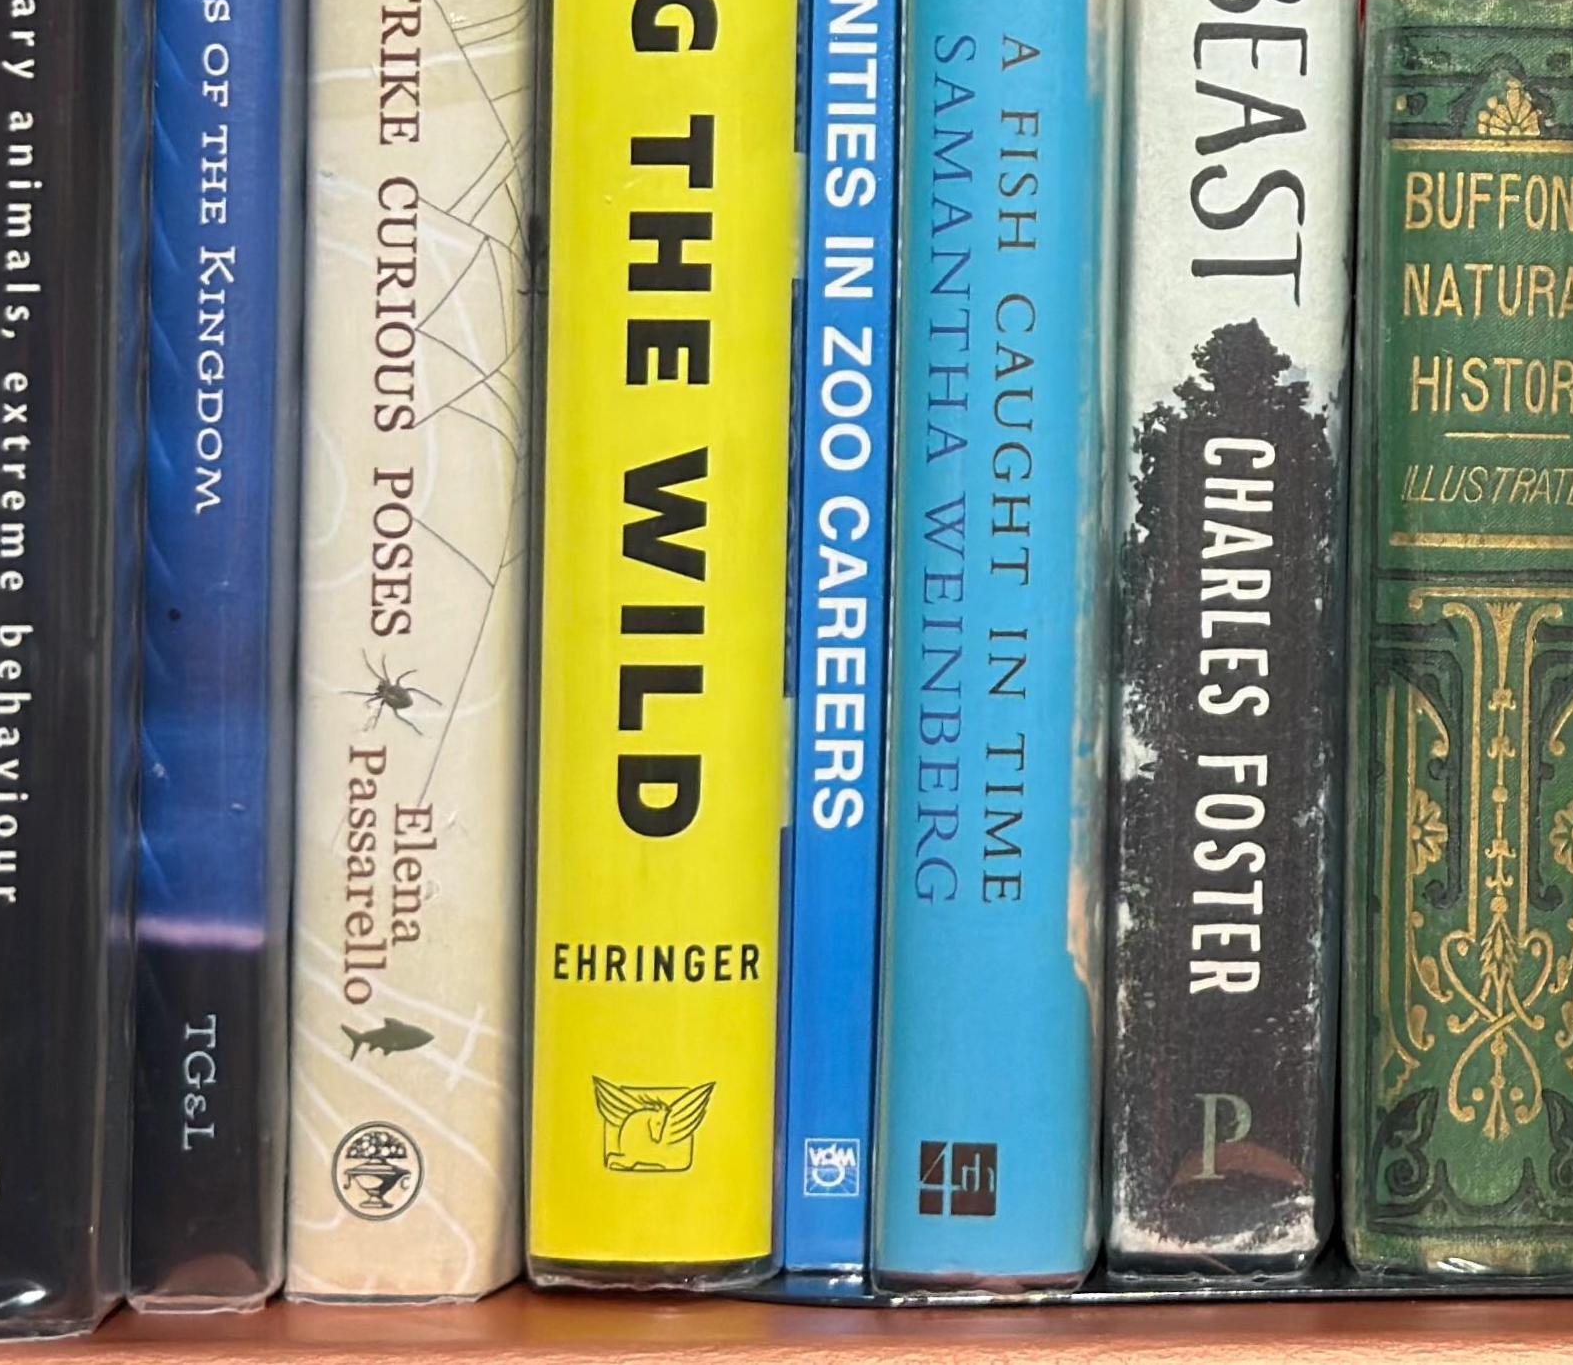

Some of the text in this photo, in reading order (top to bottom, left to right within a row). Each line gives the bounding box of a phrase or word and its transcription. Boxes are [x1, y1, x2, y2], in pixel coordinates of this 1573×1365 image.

[200, 124, 228, 224] THE
[202, 43, 230, 108] OF
[373, 176, 421, 433] CURIOUS
[625, 114, 715, 386] THE
[824, 236, 875, 299] IN
[193, 246, 236, 515] KINGDOM
[818, 326, 873, 472] ZOO
[914, 34, 977, 904] SAMANTHA WEINBERG
[982, 35, 1041, 904] A FISH CAUGHT IN TIME
[370, 466, 414, 638] POSES
[616, 446, 712, 840] WILD
[812, 495, 870, 831] CAREERS
[1189, 436, 1277, 996] CHARLES FOSTER
[342, 744, 387, 1006] Passarello
[392, 803, 436, 947] Elena
[553, 942, 761, 983] EHRINGER
[181, 1014, 217, 1152] TG&L
